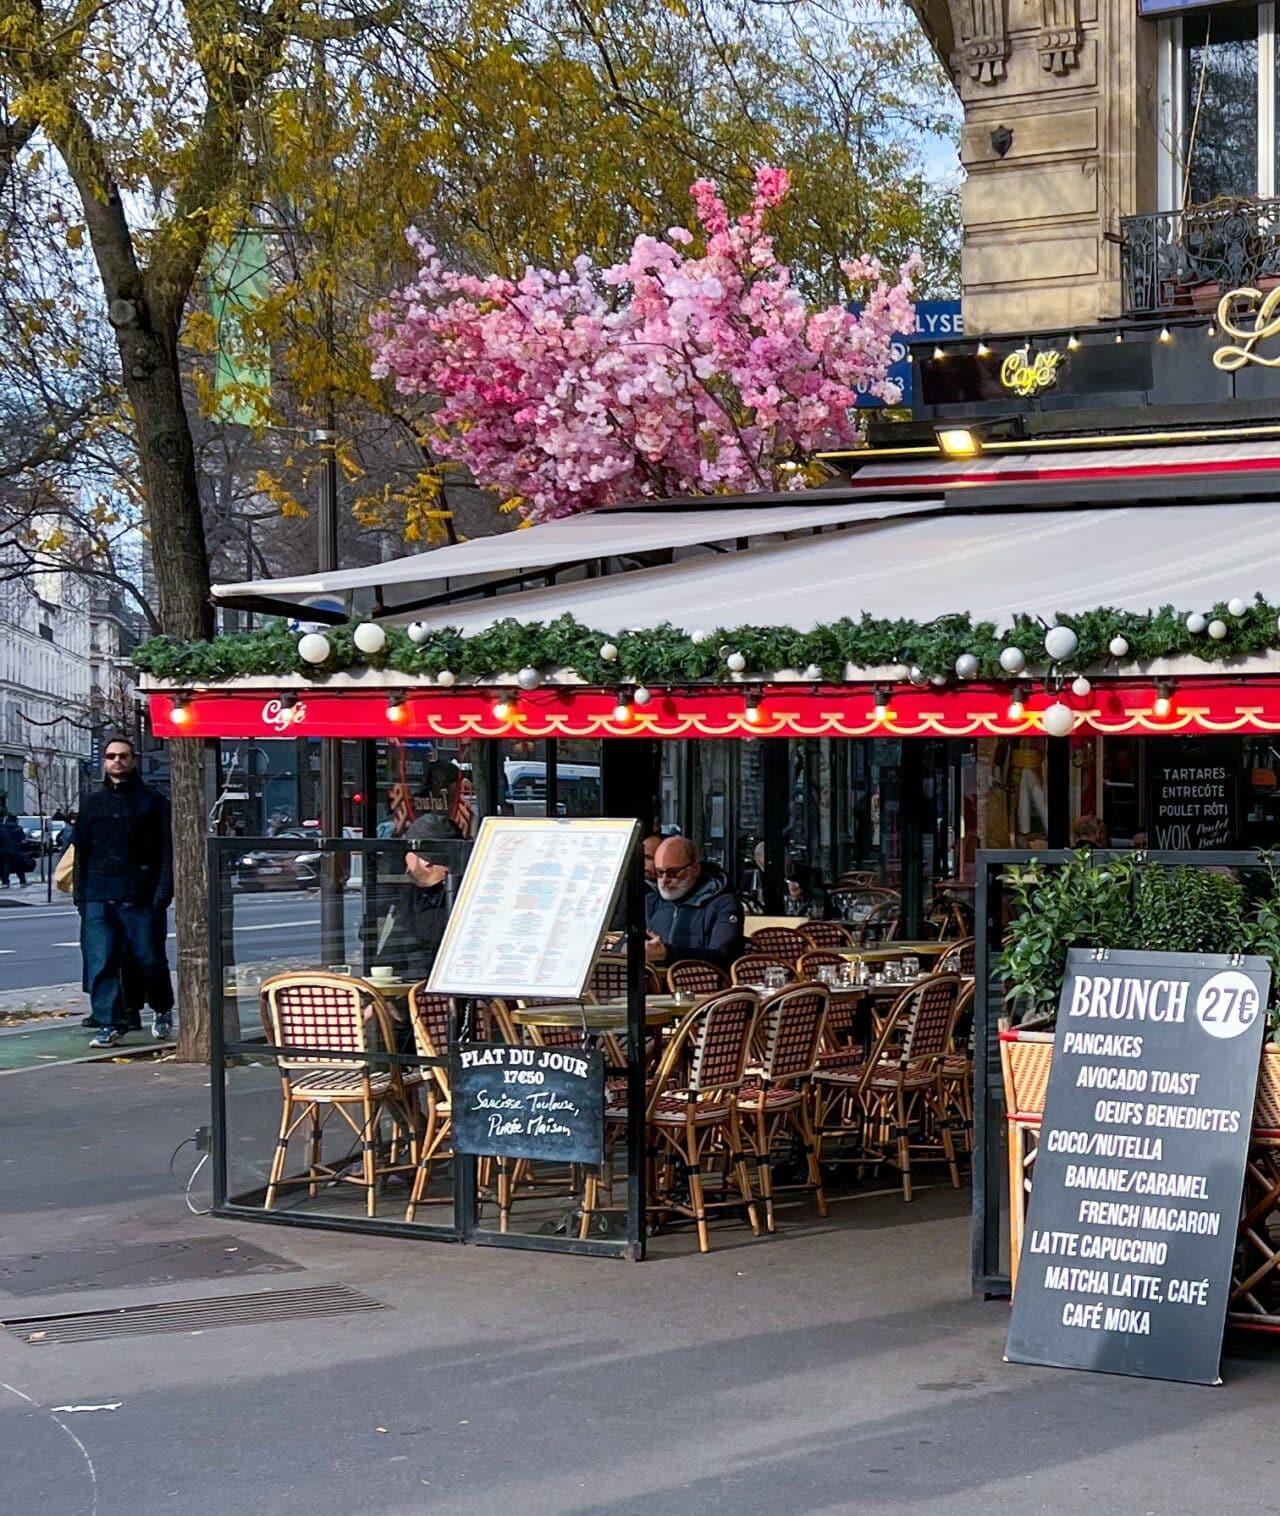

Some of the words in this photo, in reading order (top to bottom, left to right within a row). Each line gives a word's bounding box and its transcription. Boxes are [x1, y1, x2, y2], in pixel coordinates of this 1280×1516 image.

[915, 314, 963, 332] LYSE
[1001, 350, 1060, 396] Café
[1163, 768, 1226, 780] TARTARES
[1162, 784, 1225, 798] ENTRECÔTE
[1159, 805, 1199, 817] POULET
[1203, 802, 1228, 816] RÔTI
[1156, 824, 1192, 850] WOK
[1069, 975, 1190, 1022] BRUNCH
[1202, 987, 1256, 1024] 27€
[1063, 1032, 1143, 1058] PANCAKES
[460, 1049, 506, 1068] PLAT
[509, 1049, 534, 1066] DU
[538, 1052, 588, 1078] JOUR
[503, 1070, 545, 1085] 17€50
[1076, 1066, 1148, 1092] AVOCADO
[1151, 1071, 1200, 1095] TOAST
[471, 1090, 524, 1111] Saucisse
[488, 1114, 524, 1137] Purée
[526, 1115, 571, 1137] Maison
[1095, 1100, 1144, 1125] OEUFS
[1145, 1106, 1241, 1132] BENEDICTES
[1047, 1129, 1163, 1161] COCO/NUTELLA
[1065, 1165, 1209, 1199] BANANE/CARAMEL
[1078, 1200, 1140, 1228] FRENCH
[1142, 1205, 1220, 1236] MACARON
[1030, 1230, 1079, 1256] LATTE
[1080, 1235, 1168, 1265] CAPUCCINO
[1044, 1266, 1109, 1295] MATCHA
[1112, 1272, 1163, 1304] LATTE,
[1168, 1279, 1210, 1305] CAFÉ
[1062, 1303, 1103, 1329] CAFÉ
[1104, 1309, 1151, 1335] MOKA
